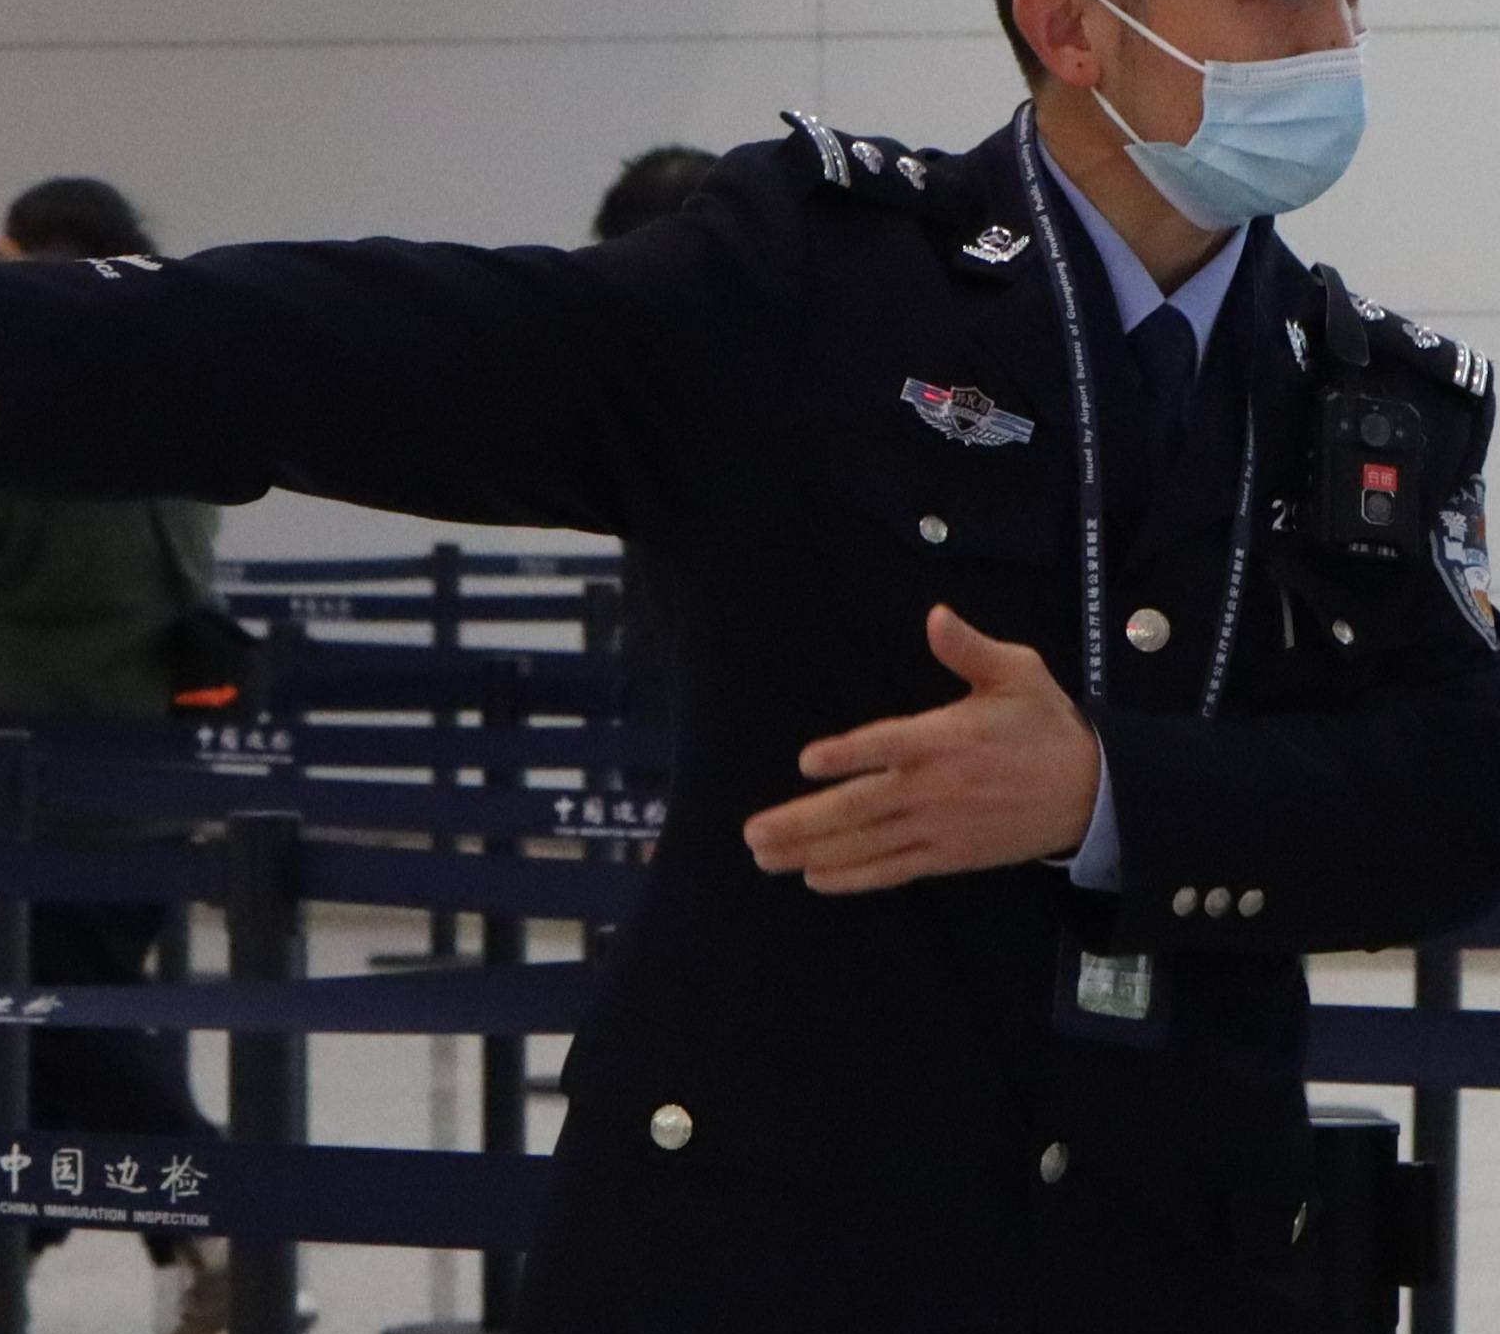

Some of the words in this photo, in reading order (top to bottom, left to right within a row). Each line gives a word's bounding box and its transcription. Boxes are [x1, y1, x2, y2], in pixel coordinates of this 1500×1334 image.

[1029, 185, 1046, 213] Public
[1041, 214, 1061, 259] Provincial
[1056, 261, 1077, 320] Guangdong
[1076, 342, 1086, 379] Bureau
[1081, 384, 1093, 425] Airport
[1084, 429, 1093, 445] by
[1087, 518, 1100, 696] 广东省公安厅机场公安局制发
[43, 1204, 127, 1222] IMMIGRATION
[132, 1210, 210, 1227] INSPECTION
